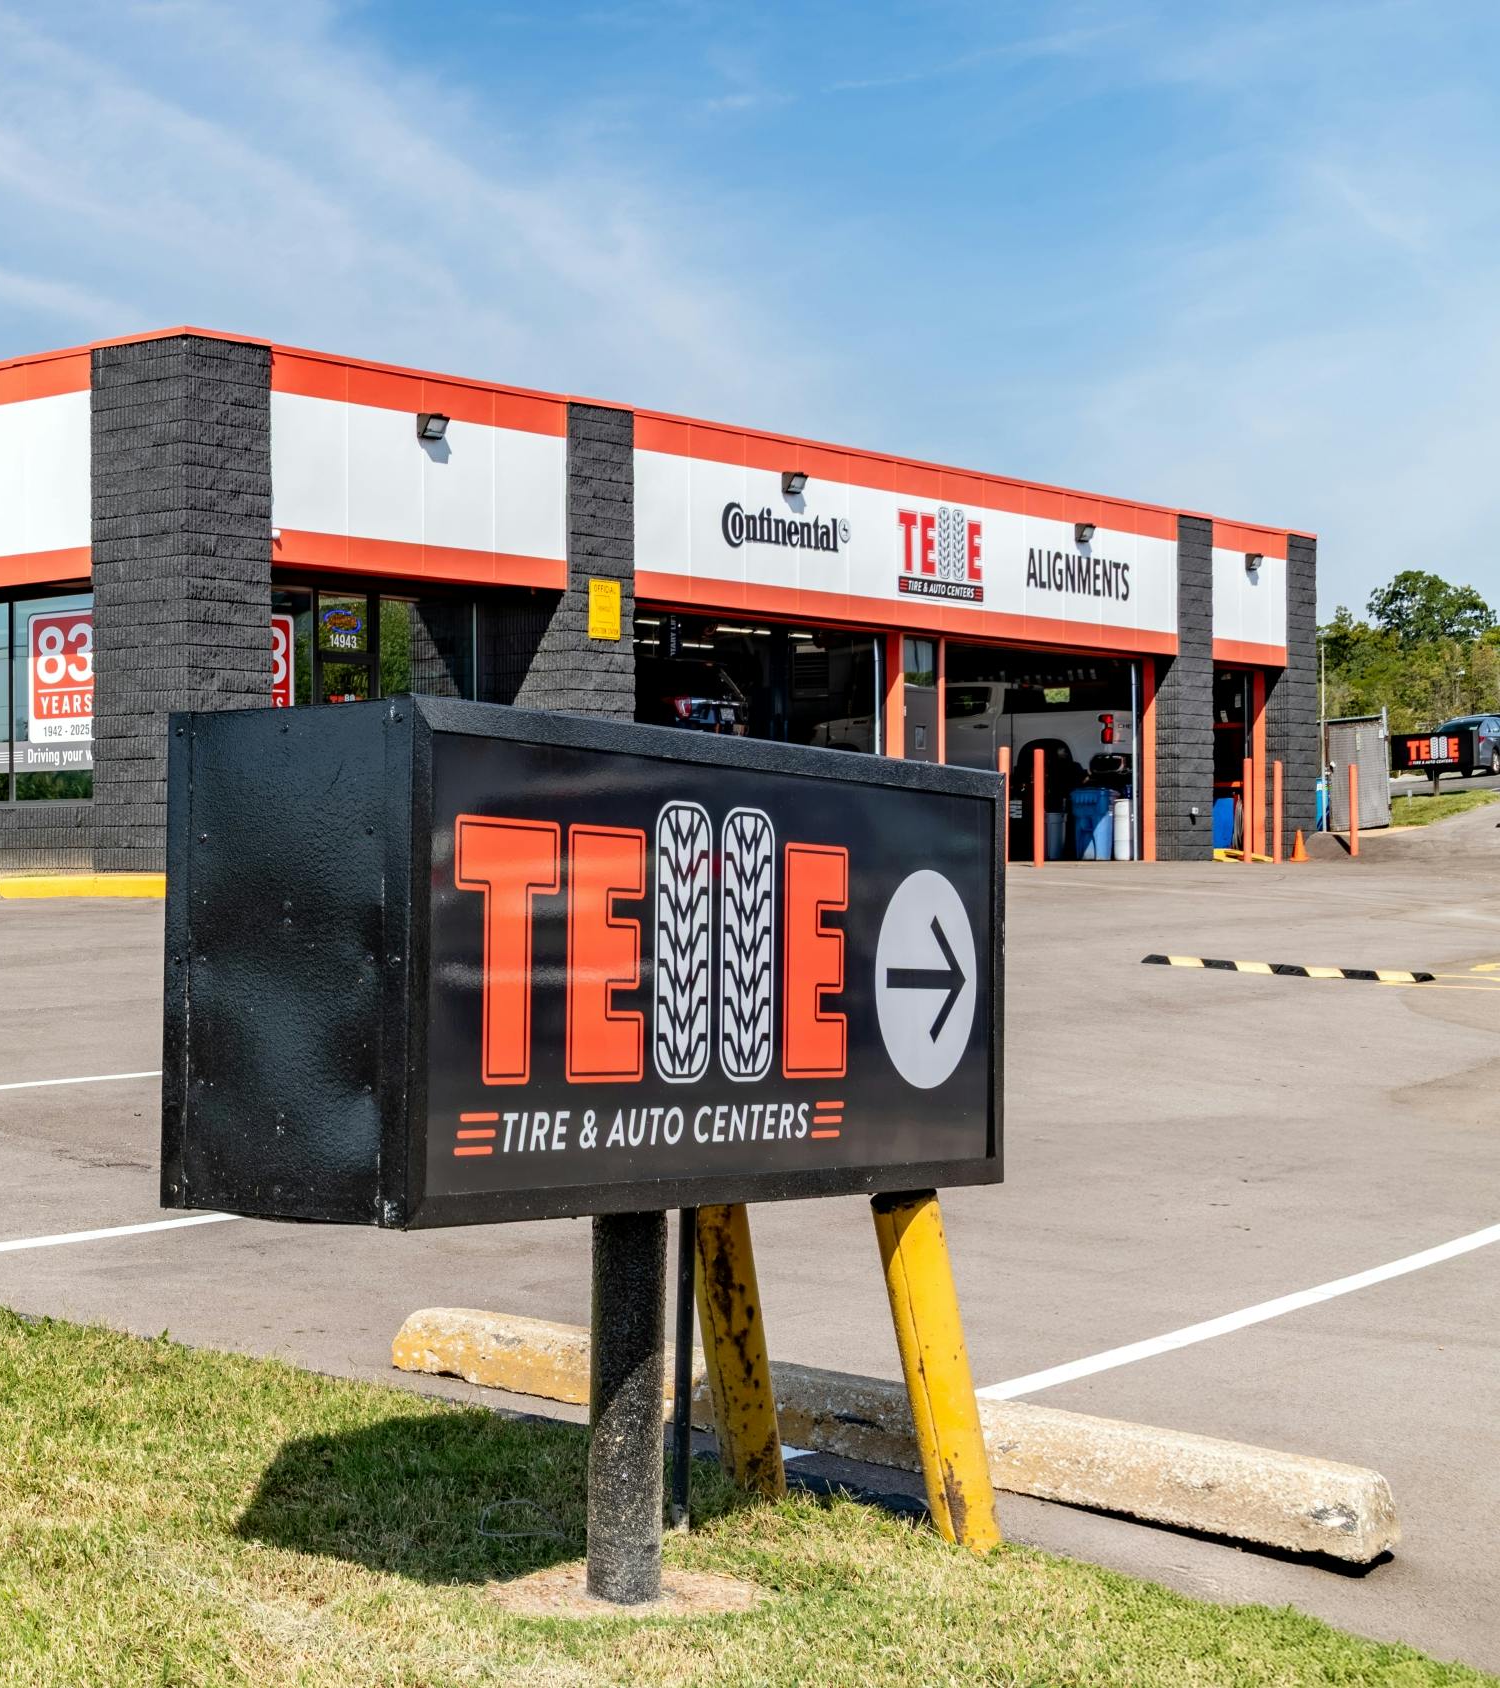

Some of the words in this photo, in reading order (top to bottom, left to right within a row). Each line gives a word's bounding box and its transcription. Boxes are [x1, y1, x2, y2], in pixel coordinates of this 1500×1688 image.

[722, 502, 839, 553] Continental
[1026, 547, 1131, 602] ALIGNMENTS
[908, 580, 922, 592] TIRE
[923, 582, 929, 593] &
[929, 582, 946, 595] AUTO
[947, 585, 975, 598] CENTERS
[330, 634, 357, 648] 14943
[36, 623, 93, 684] 83
[40, 694, 92, 715] YEARS
[43, 725, 63, 737] 1942
[70, 723, 90, 736] 2025
[27, 748, 60, 765] Driving
[62, 750, 83, 766] your
[502, 1110, 571, 1154] TIRE
[579, 1109, 598, 1150] &
[605, 1106, 684, 1149] AUTO
[693, 1102, 811, 1144] CENTERS
